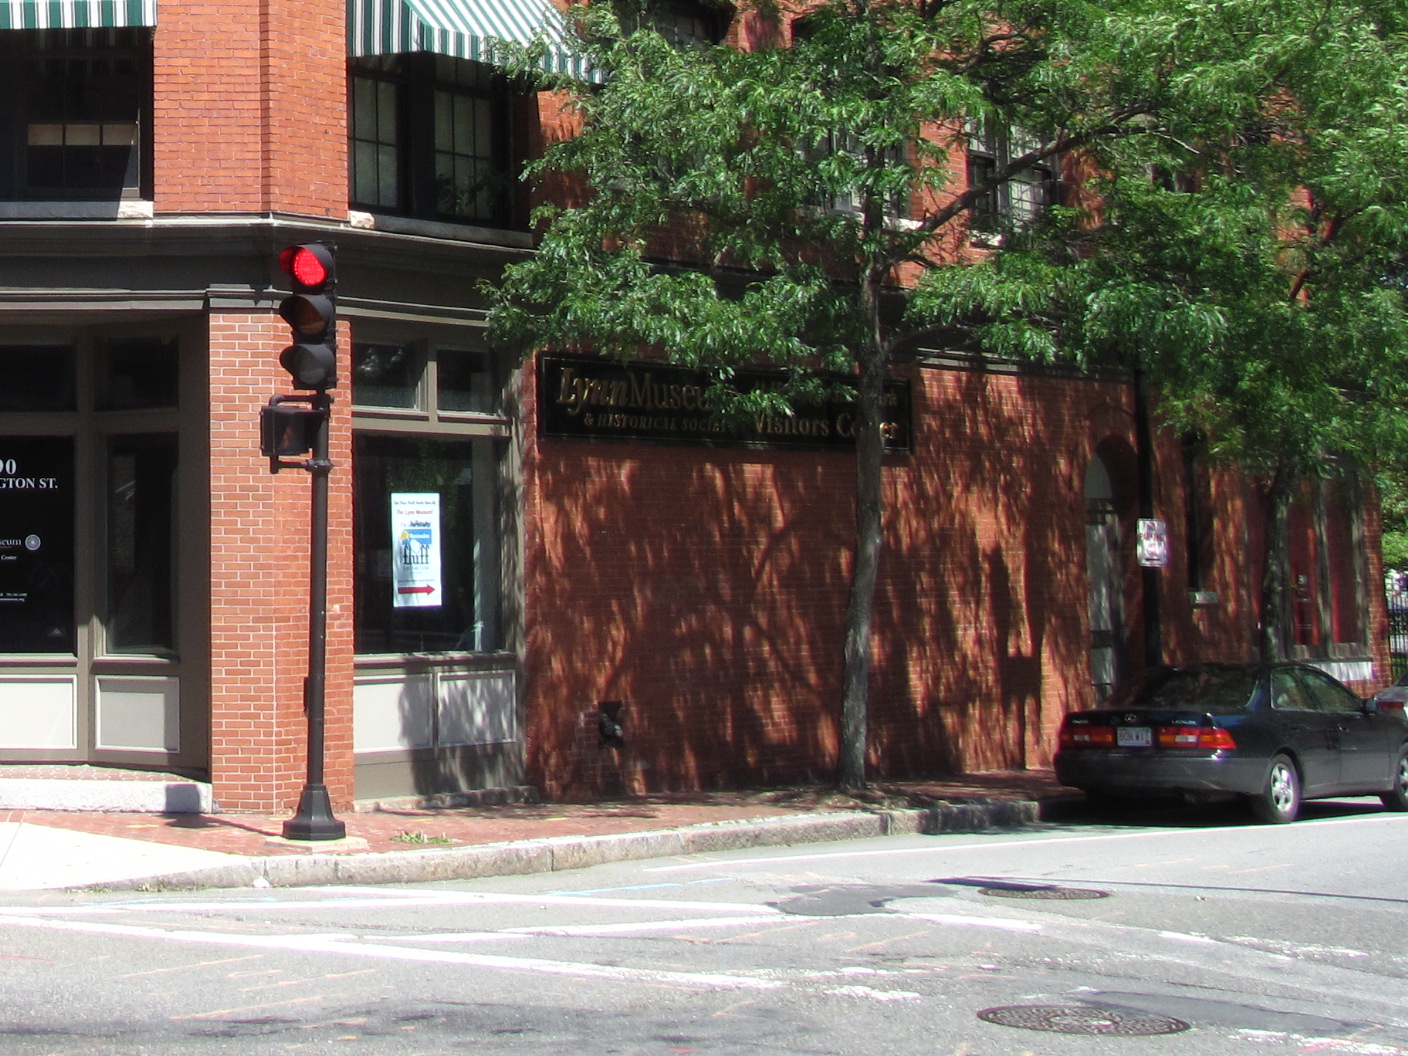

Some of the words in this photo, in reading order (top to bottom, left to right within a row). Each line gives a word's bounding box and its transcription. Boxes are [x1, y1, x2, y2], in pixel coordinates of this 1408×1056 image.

[584, 412, 594, 426] &
[597, 413, 677, 430] HISTORICAL
[39, 477, 58, 489] ST.
